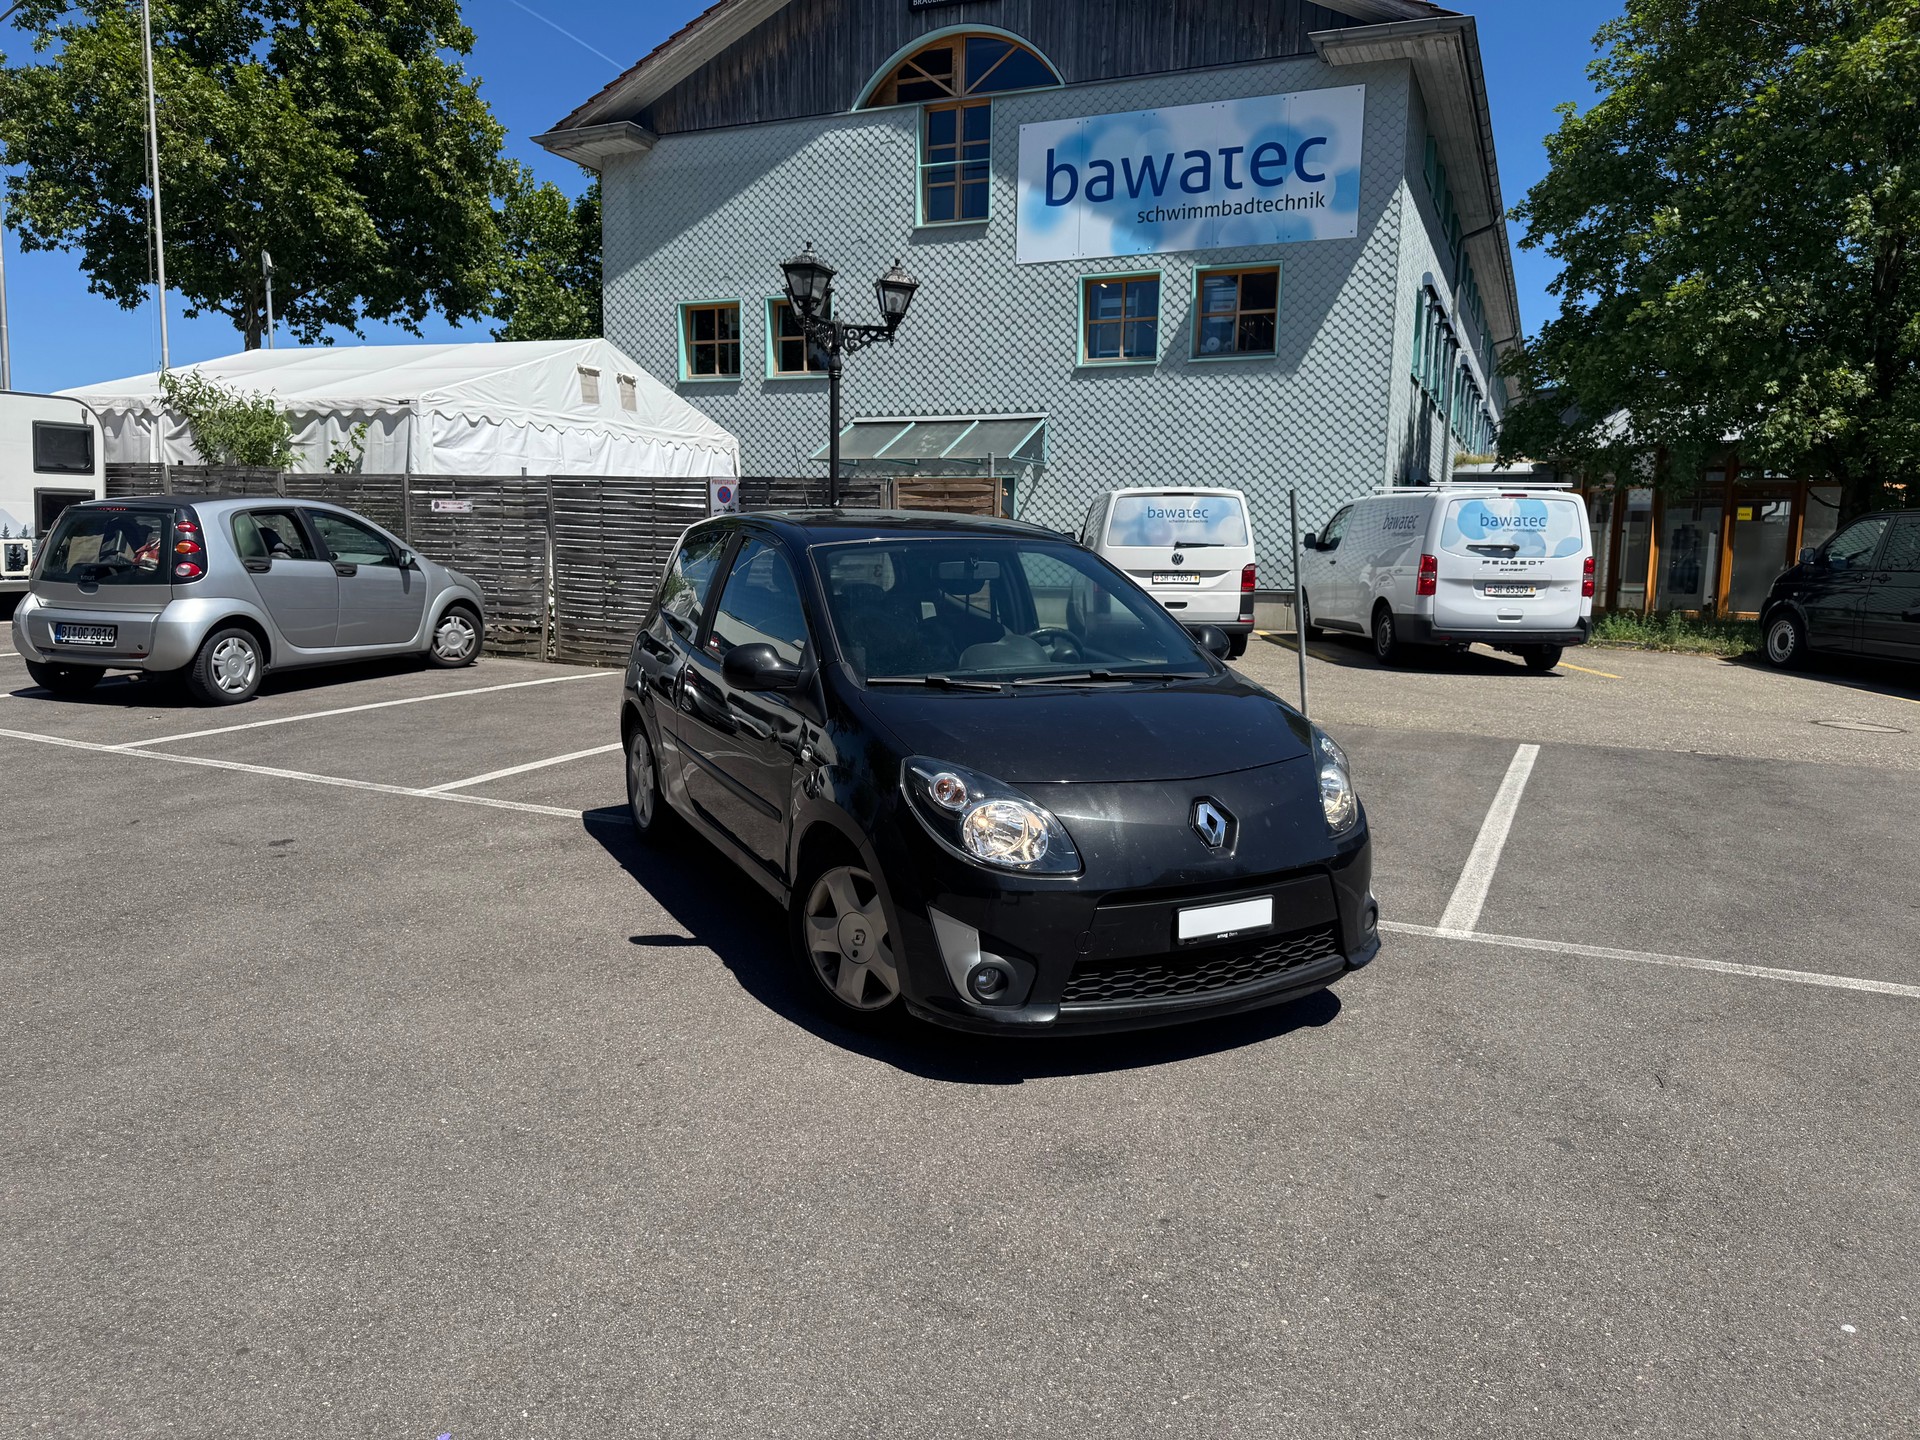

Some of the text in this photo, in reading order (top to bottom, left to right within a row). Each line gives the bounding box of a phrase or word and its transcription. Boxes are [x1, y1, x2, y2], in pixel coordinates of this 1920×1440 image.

[1045, 136, 1328, 208] bawatec
[1137, 190, 1326, 224] schwimmbadtechnik
[1147, 505, 1209, 519] bawatec
[1480, 512, 1546, 527] bawatec
[1382, 512, 1419, 530] bawatec
[1505, 584, 1529, 594] 65309
[90, 627, 113, 641] 2816
